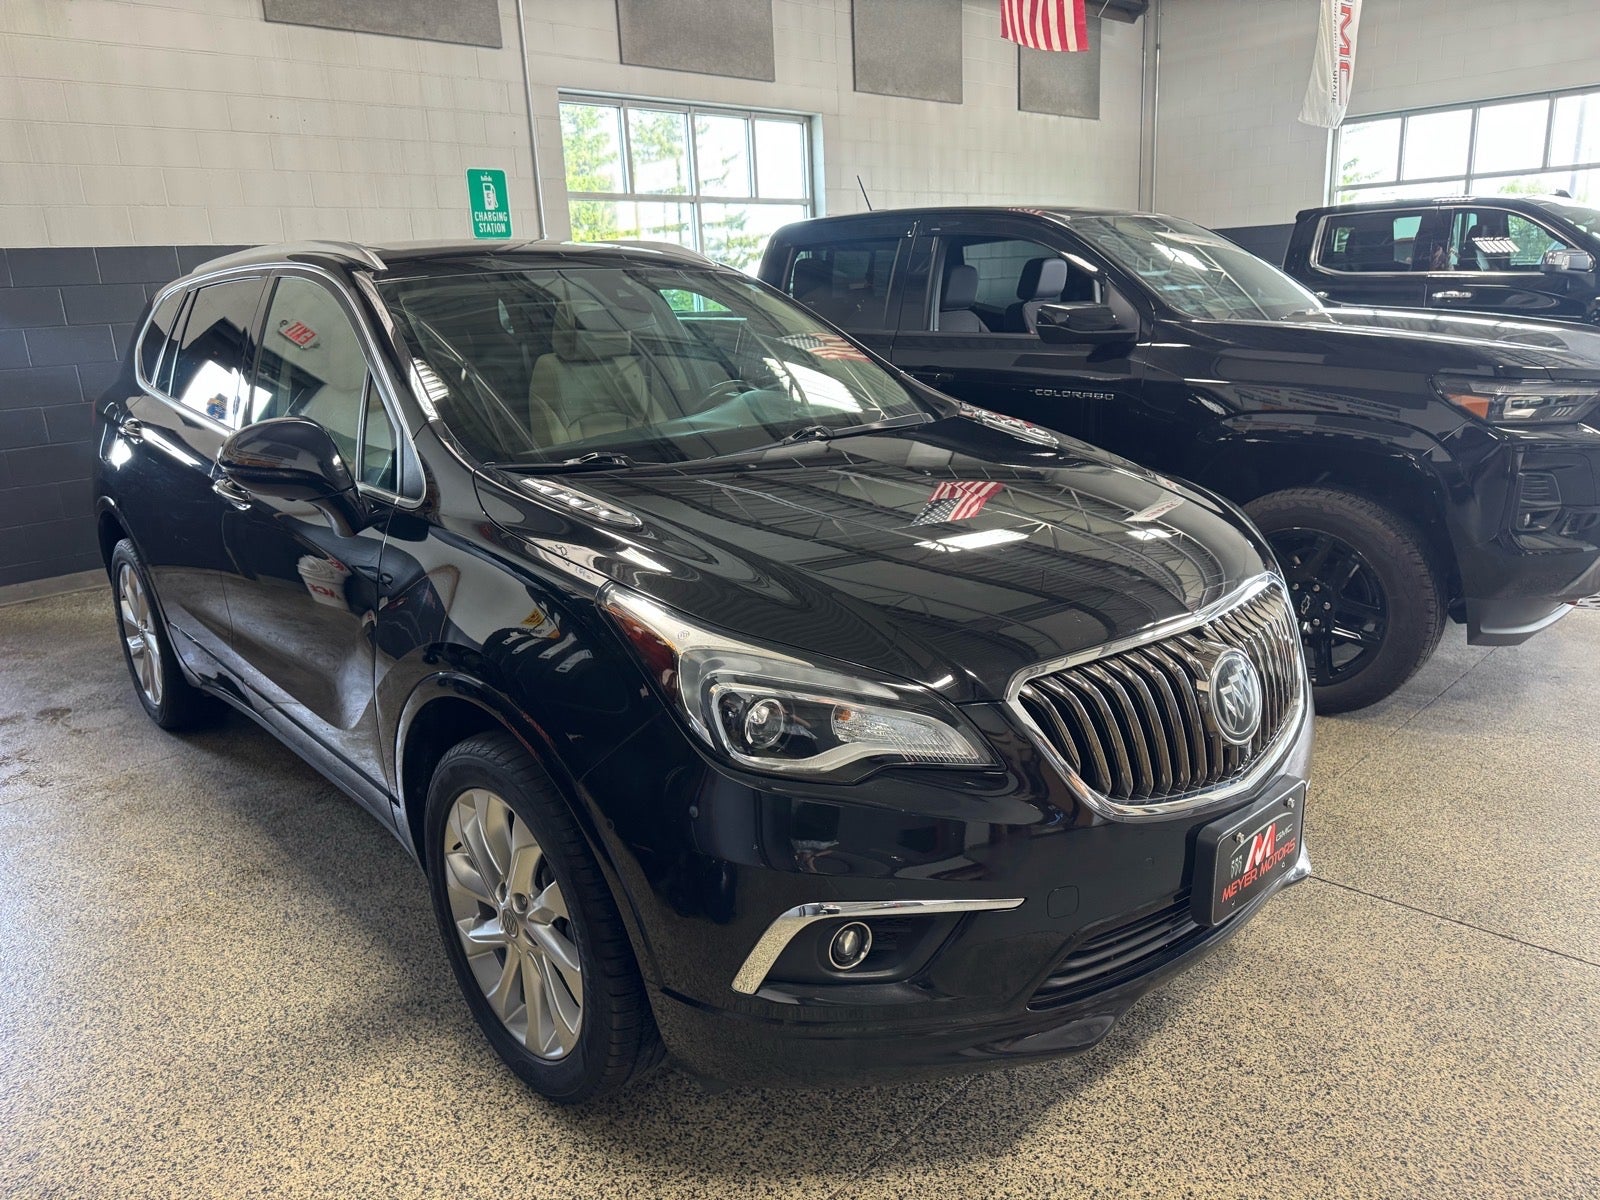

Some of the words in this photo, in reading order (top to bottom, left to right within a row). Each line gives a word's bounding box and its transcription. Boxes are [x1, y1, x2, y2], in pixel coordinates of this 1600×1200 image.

[1338, 0, 1354, 106] MC
[474, 211, 508, 222] CHARGING
[479, 222, 506, 234] STATION
[1034, 388, 1115, 401] COLORADO
[1276, 823, 1293, 842] GMC
[1221, 867, 1258, 903] MEYER
[1259, 837, 1296, 877] MOTORS
